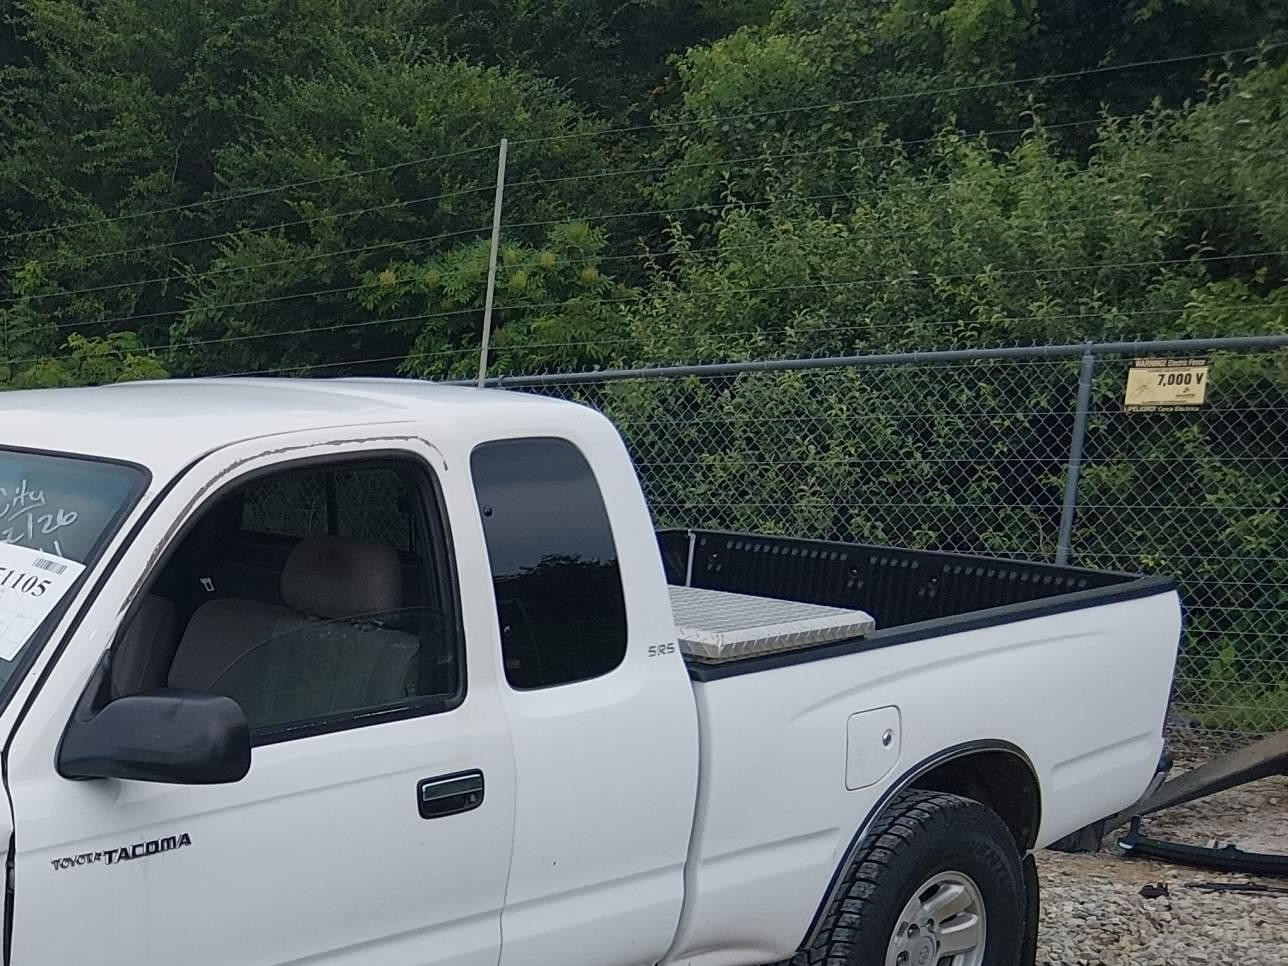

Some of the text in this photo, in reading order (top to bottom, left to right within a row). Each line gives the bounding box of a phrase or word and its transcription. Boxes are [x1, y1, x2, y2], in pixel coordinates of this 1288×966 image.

[1157, 372, 1204, 387] 7,000 V
[51, 832, 192, 871] TOYOTA TACOMA
